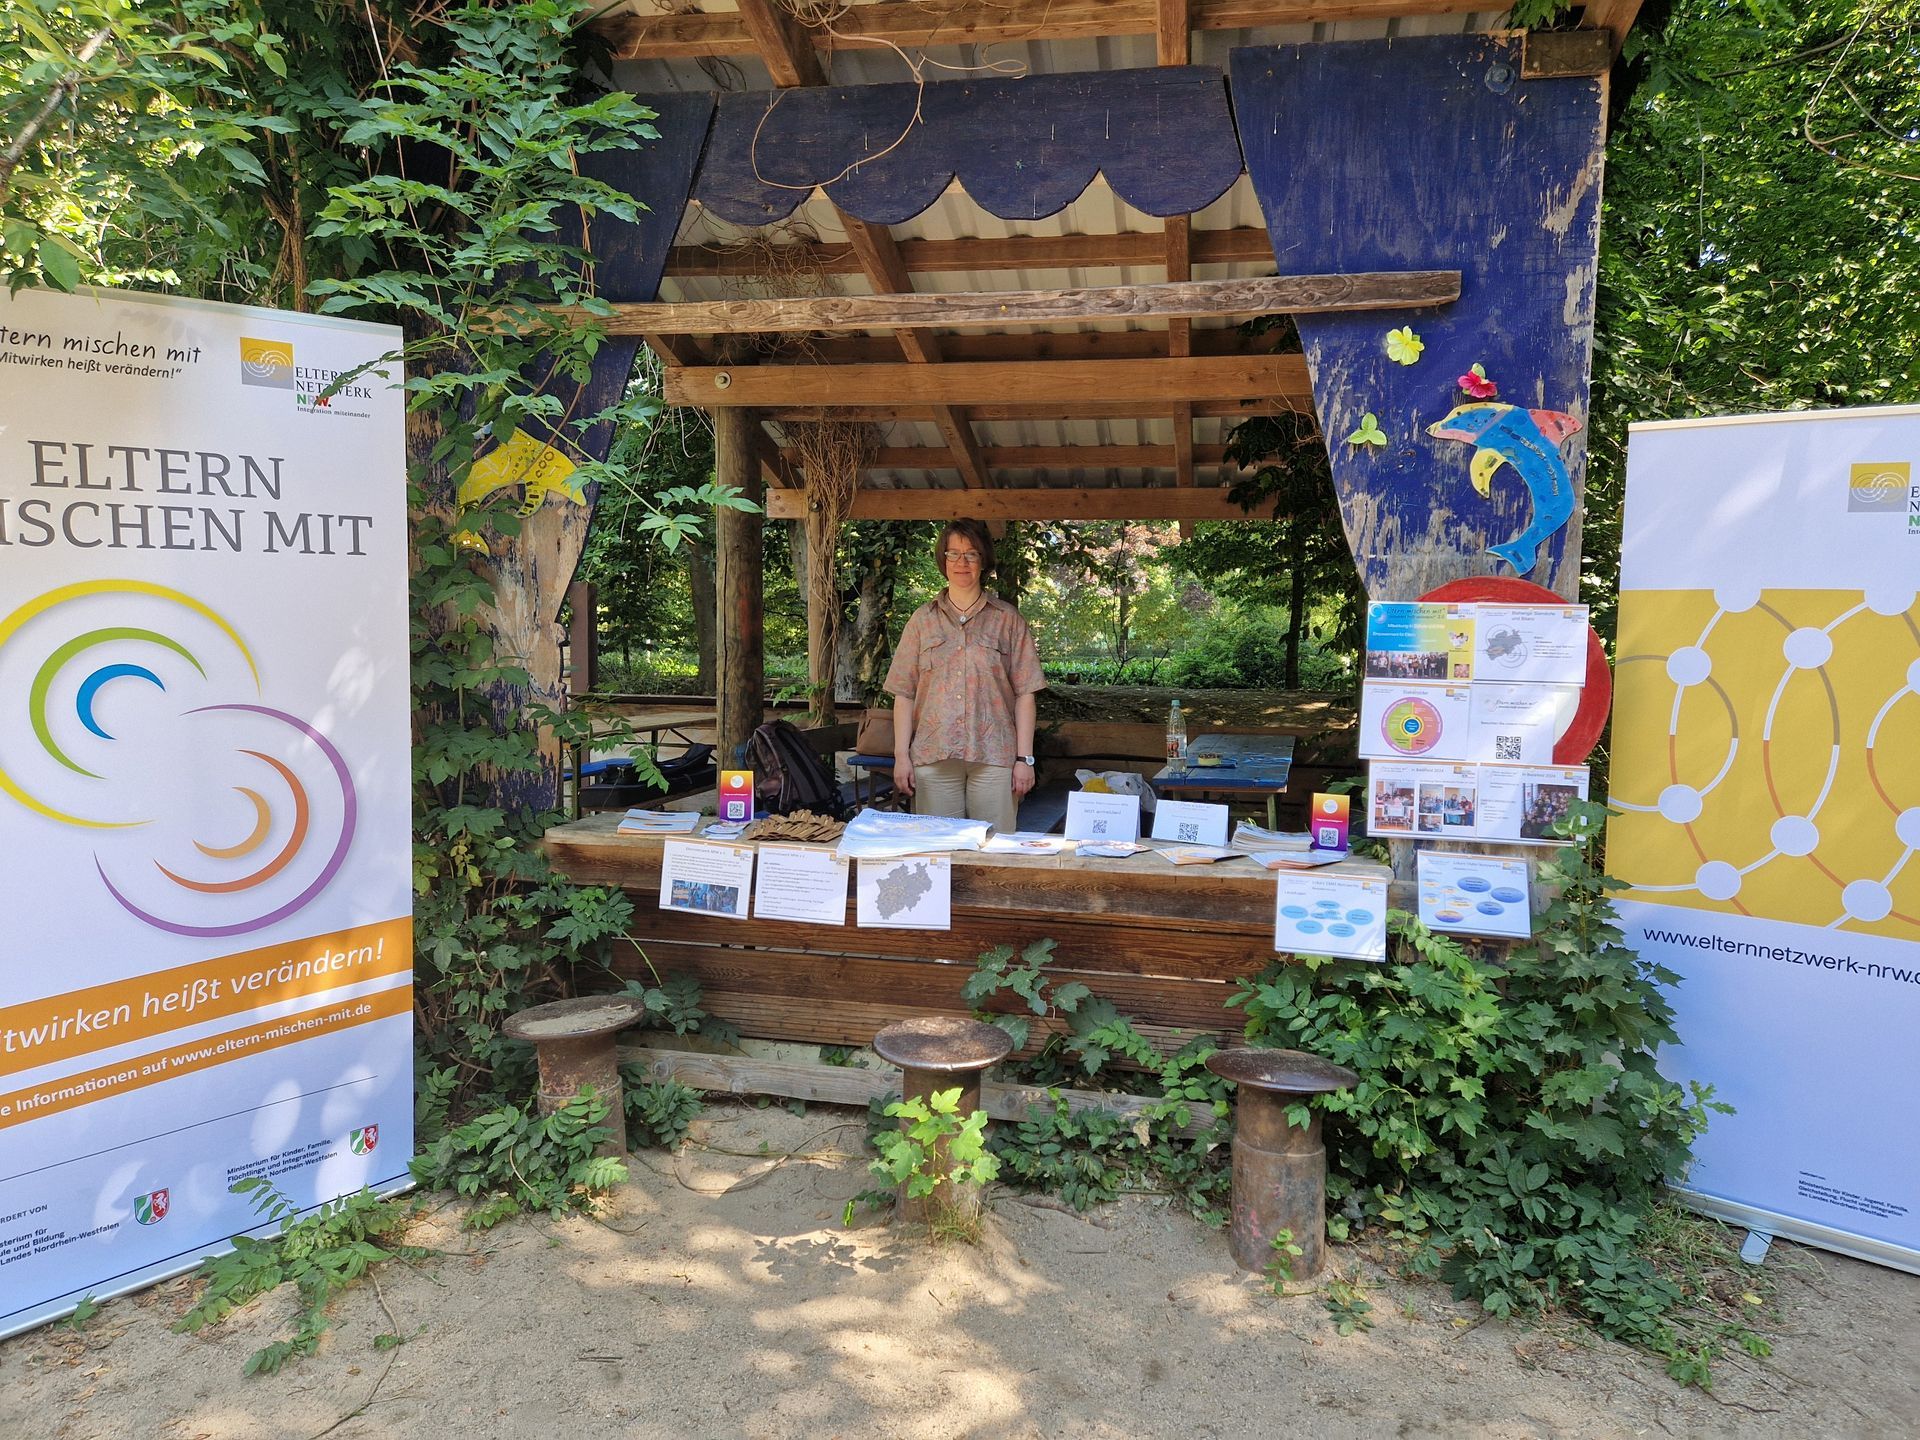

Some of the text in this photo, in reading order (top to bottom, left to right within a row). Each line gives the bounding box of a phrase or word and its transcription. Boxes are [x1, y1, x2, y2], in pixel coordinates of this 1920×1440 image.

[63, 331, 155, 359] mischen
[166, 347, 201, 363] mit
[67, 357, 101, 373] heißt
[334, 410, 371, 418] miteinander
[28, 440, 285, 500] ELTERN
[263, 510, 373, 556] MIT
[142, 978, 221, 1018] heißt
[230, 937, 385, 994] verändern!
[16, 1069, 138, 1112] Informationen
[142, 1057, 168, 1076] auf
[172, 1002, 372, 1067] www.eltern-mischen-mit.de
[227, 1158, 268, 1175] Ministerium
[282, 1147, 305, 1158] Kinder,
[307, 1139, 333, 1150] Familie,
[227, 1150, 319, 1182] Flüchtlinge und Integration
[269, 1152, 338, 1177] Nordrhein-Westfalen
[29, 1204, 48, 1214] VON
[0, 1221, 120, 1266] Landes Nordrhein-Westfalen
[13, 1241, 30, 1252] und
[32, 1231, 66, 1246] Bildung
[35, 1228, 48, 1236] für
